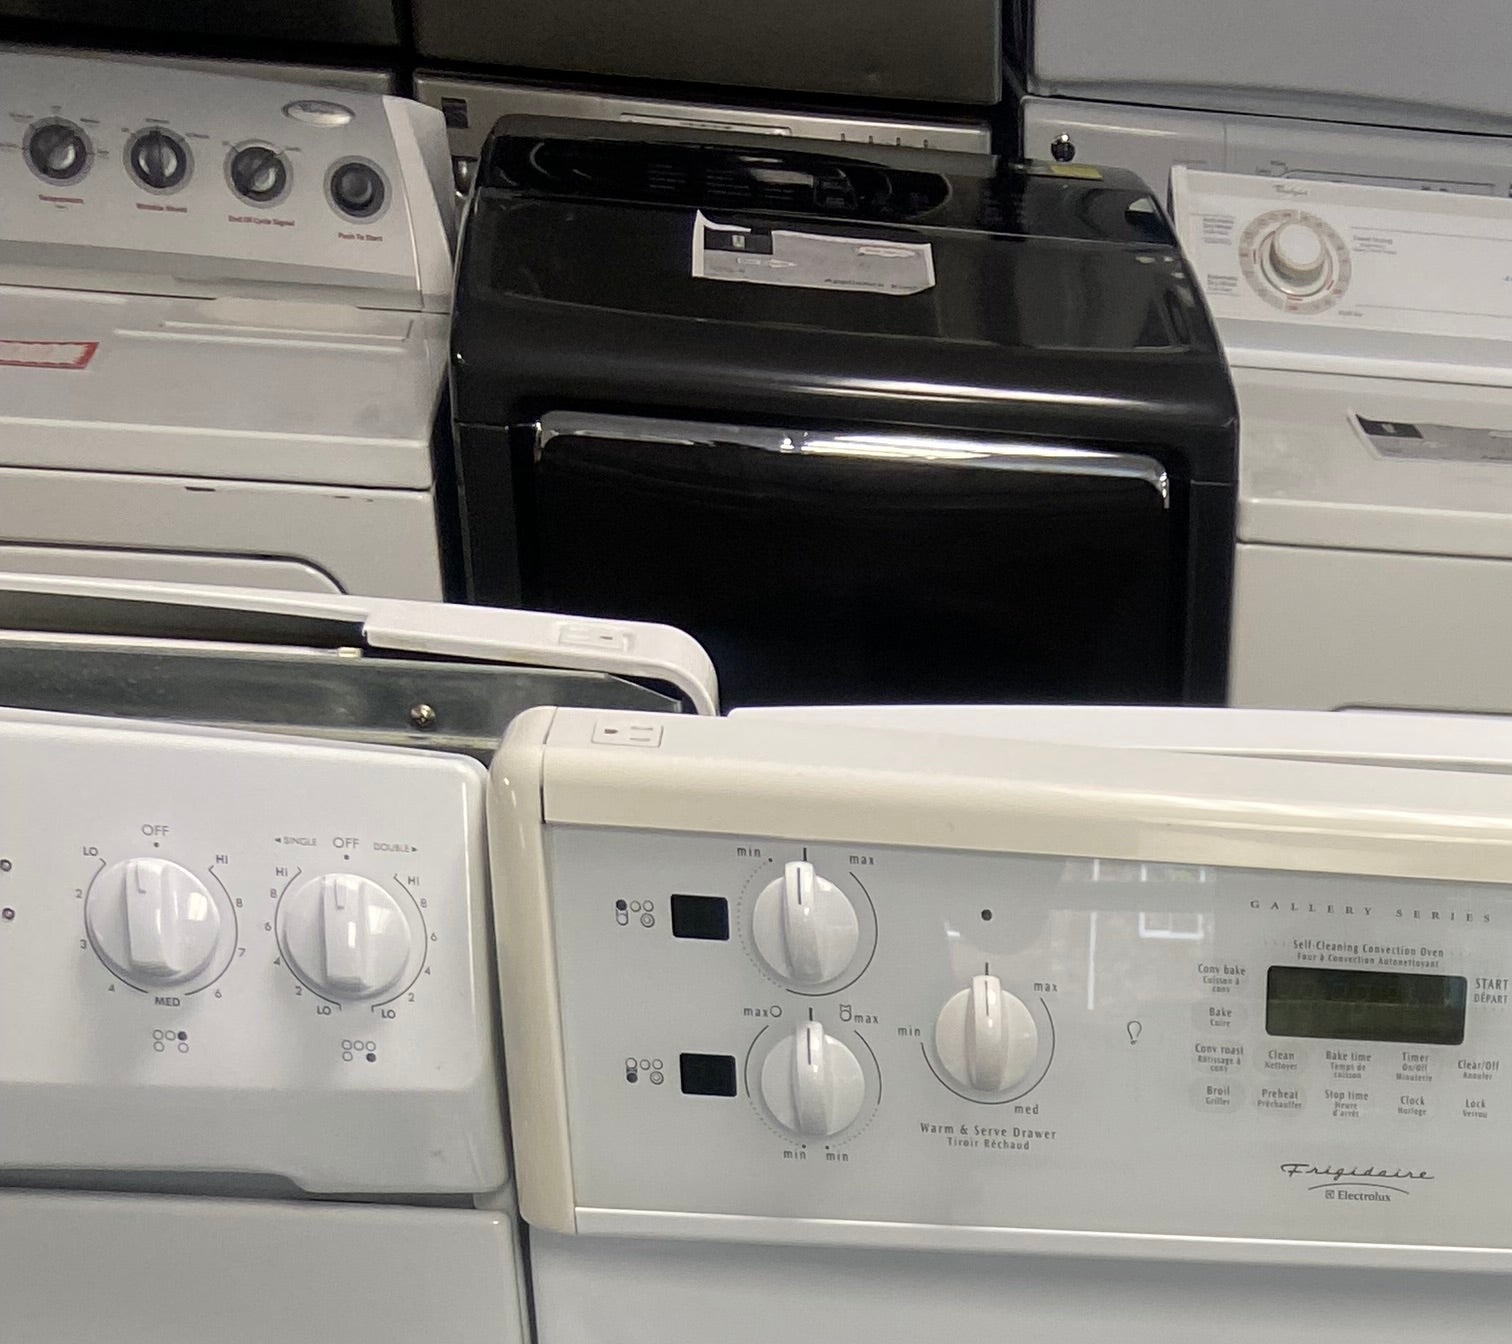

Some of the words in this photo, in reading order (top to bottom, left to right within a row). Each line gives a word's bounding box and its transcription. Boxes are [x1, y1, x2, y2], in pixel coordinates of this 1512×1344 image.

[142, 824, 169, 837] OFF
[283, 836, 317, 846] SINGLE
[333, 837, 359, 849] OFF
[83, 846, 98, 857] LO
[373, 842, 410, 853] DOUBLE
[737, 846, 761, 858] min
[215, 854, 229, 865] HI
[849, 854, 875, 865] max
[1250, 900, 1372, 917] GALLERY
[1396, 908, 1491, 923] SERIES
[238, 947, 246, 957] 7
[1362, 944, 1416, 957] Convection
[1420, 947, 1444, 958] Oven
[1224, 964, 1246, 976] bake
[1033, 981, 1058, 993] max
[1475, 978, 1508, 990] START
[154, 996, 181, 1007] MED
[1473, 992, 1508, 1004] DÉPART
[317, 1006, 331, 1016] LO
[381, 1009, 396, 1019] LO
[743, 1005, 768, 1017] max
[1209, 1007, 1232, 1018] Bake
[854, 1013, 879, 1024] max
[897, 1025, 921, 1037] min
[1268, 1049, 1295, 1060] Clean
[1326, 1050, 1348, 1061] Bake
[1402, 1052, 1429, 1063] Timer
[1458, 1060, 1500, 1071] Clear/Off
[1207, 1085, 1230, 1096] Broil
[1262, 1088, 1298, 1100] Preheat
[1325, 1089, 1345, 1101] Stop
[1348, 1091, 1368, 1101] time
[1400, 1096, 1425, 1105] Clock
[1465, 1099, 1486, 1108] Lock
[1014, 1104, 1039, 1116] med
[920, 1122, 954, 1134] Warm
[960, 1124, 968, 1135] &
[974, 1125, 1007, 1137] Serve
[1013, 1127, 1057, 1139] Drawer
[947, 1137, 979, 1147] Tiroir
[783, 1149, 806, 1160] min
[826, 1151, 848, 1162] min
[1280, 1163, 1435, 1181] Frigidaire
[1338, 1190, 1392, 1202] Electrolux
